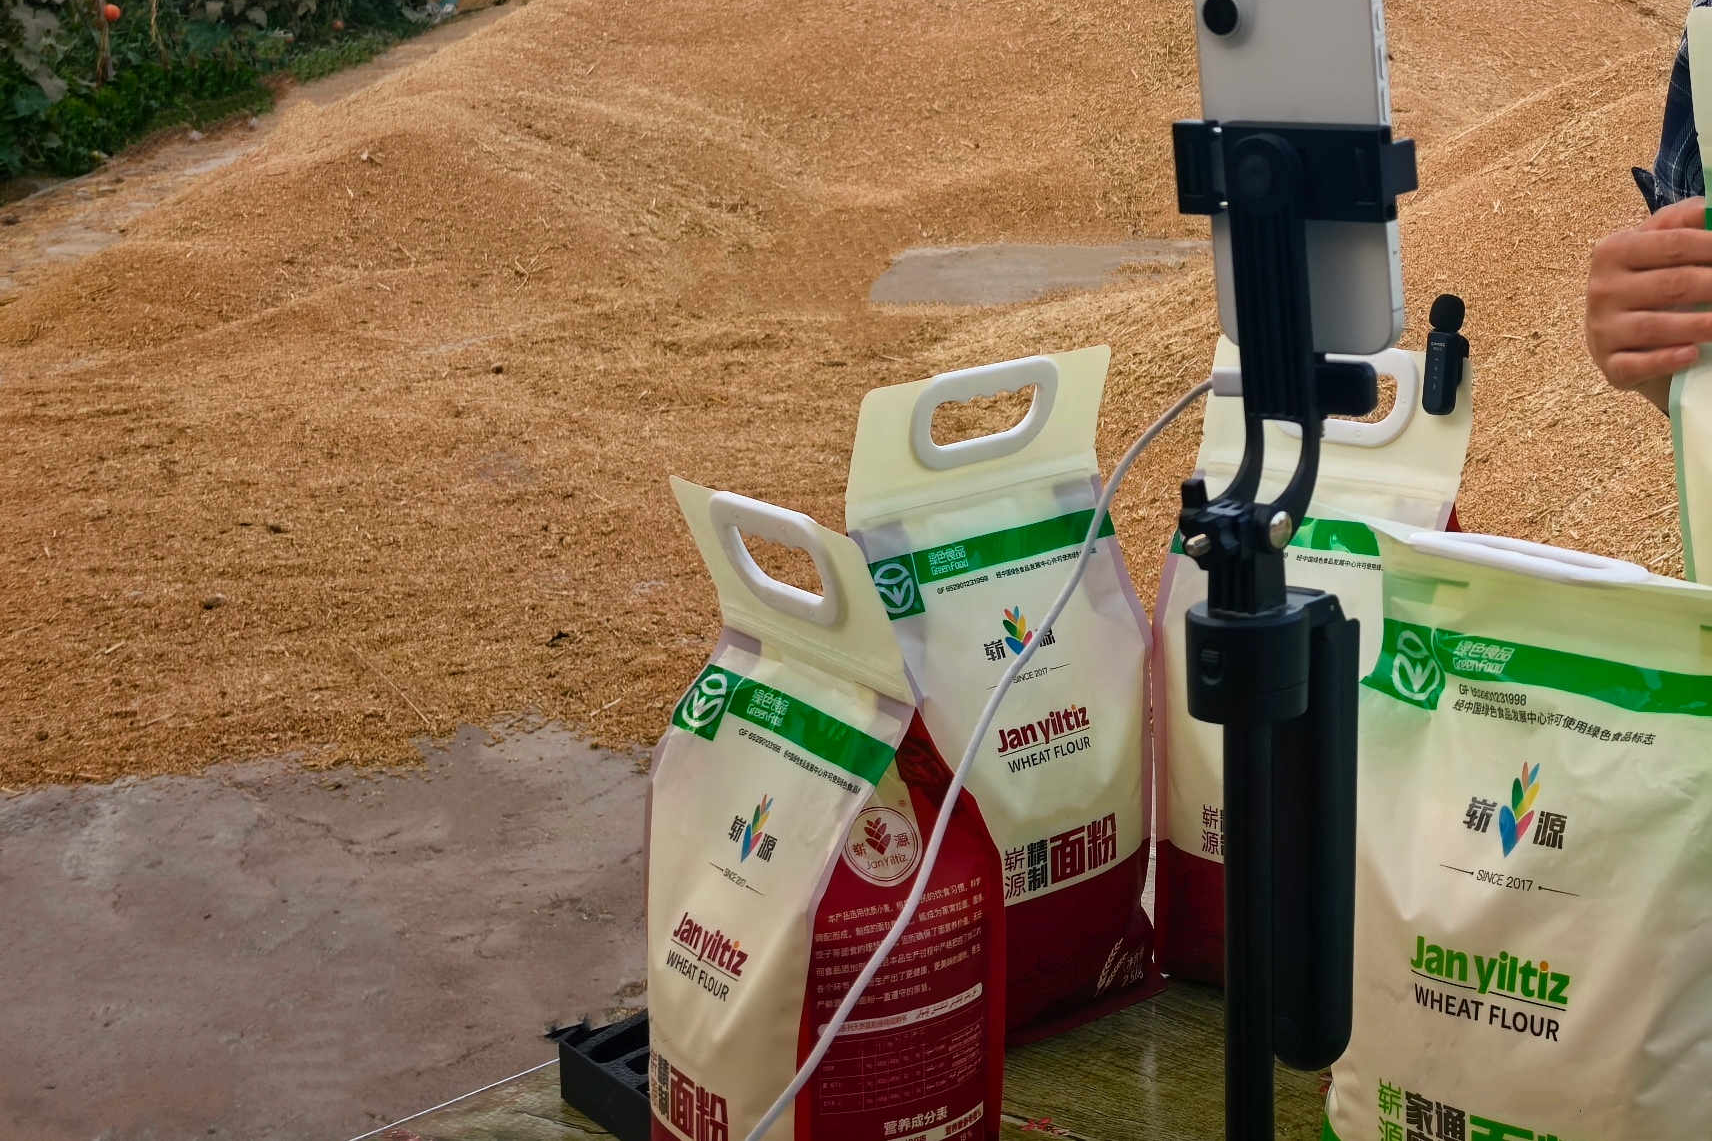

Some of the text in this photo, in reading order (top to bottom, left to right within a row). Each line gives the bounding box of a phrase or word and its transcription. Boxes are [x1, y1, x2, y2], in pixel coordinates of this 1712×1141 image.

[1453, 640, 1515, 662] 绿色食品
[1012, 666, 1049, 684] SINCE 2017
[1459, 684, 1469, 696] GF
[738, 727, 749, 737] GF
[1008, 736, 1092, 774] WHEAT FLOUR
[1027, 839, 1048, 892] 精制
[1049, 812, 1117, 885] 面粉
[1476, 869, 1534, 892] SINCE 2017
[666, 949, 730, 1002] WHEAT FLOUR
[1414, 983, 1560, 1043] WHEAT FLOUR
[670, 1064, 729, 1141] 面粉
[883, 1105, 948, 1136] 营养成分表
